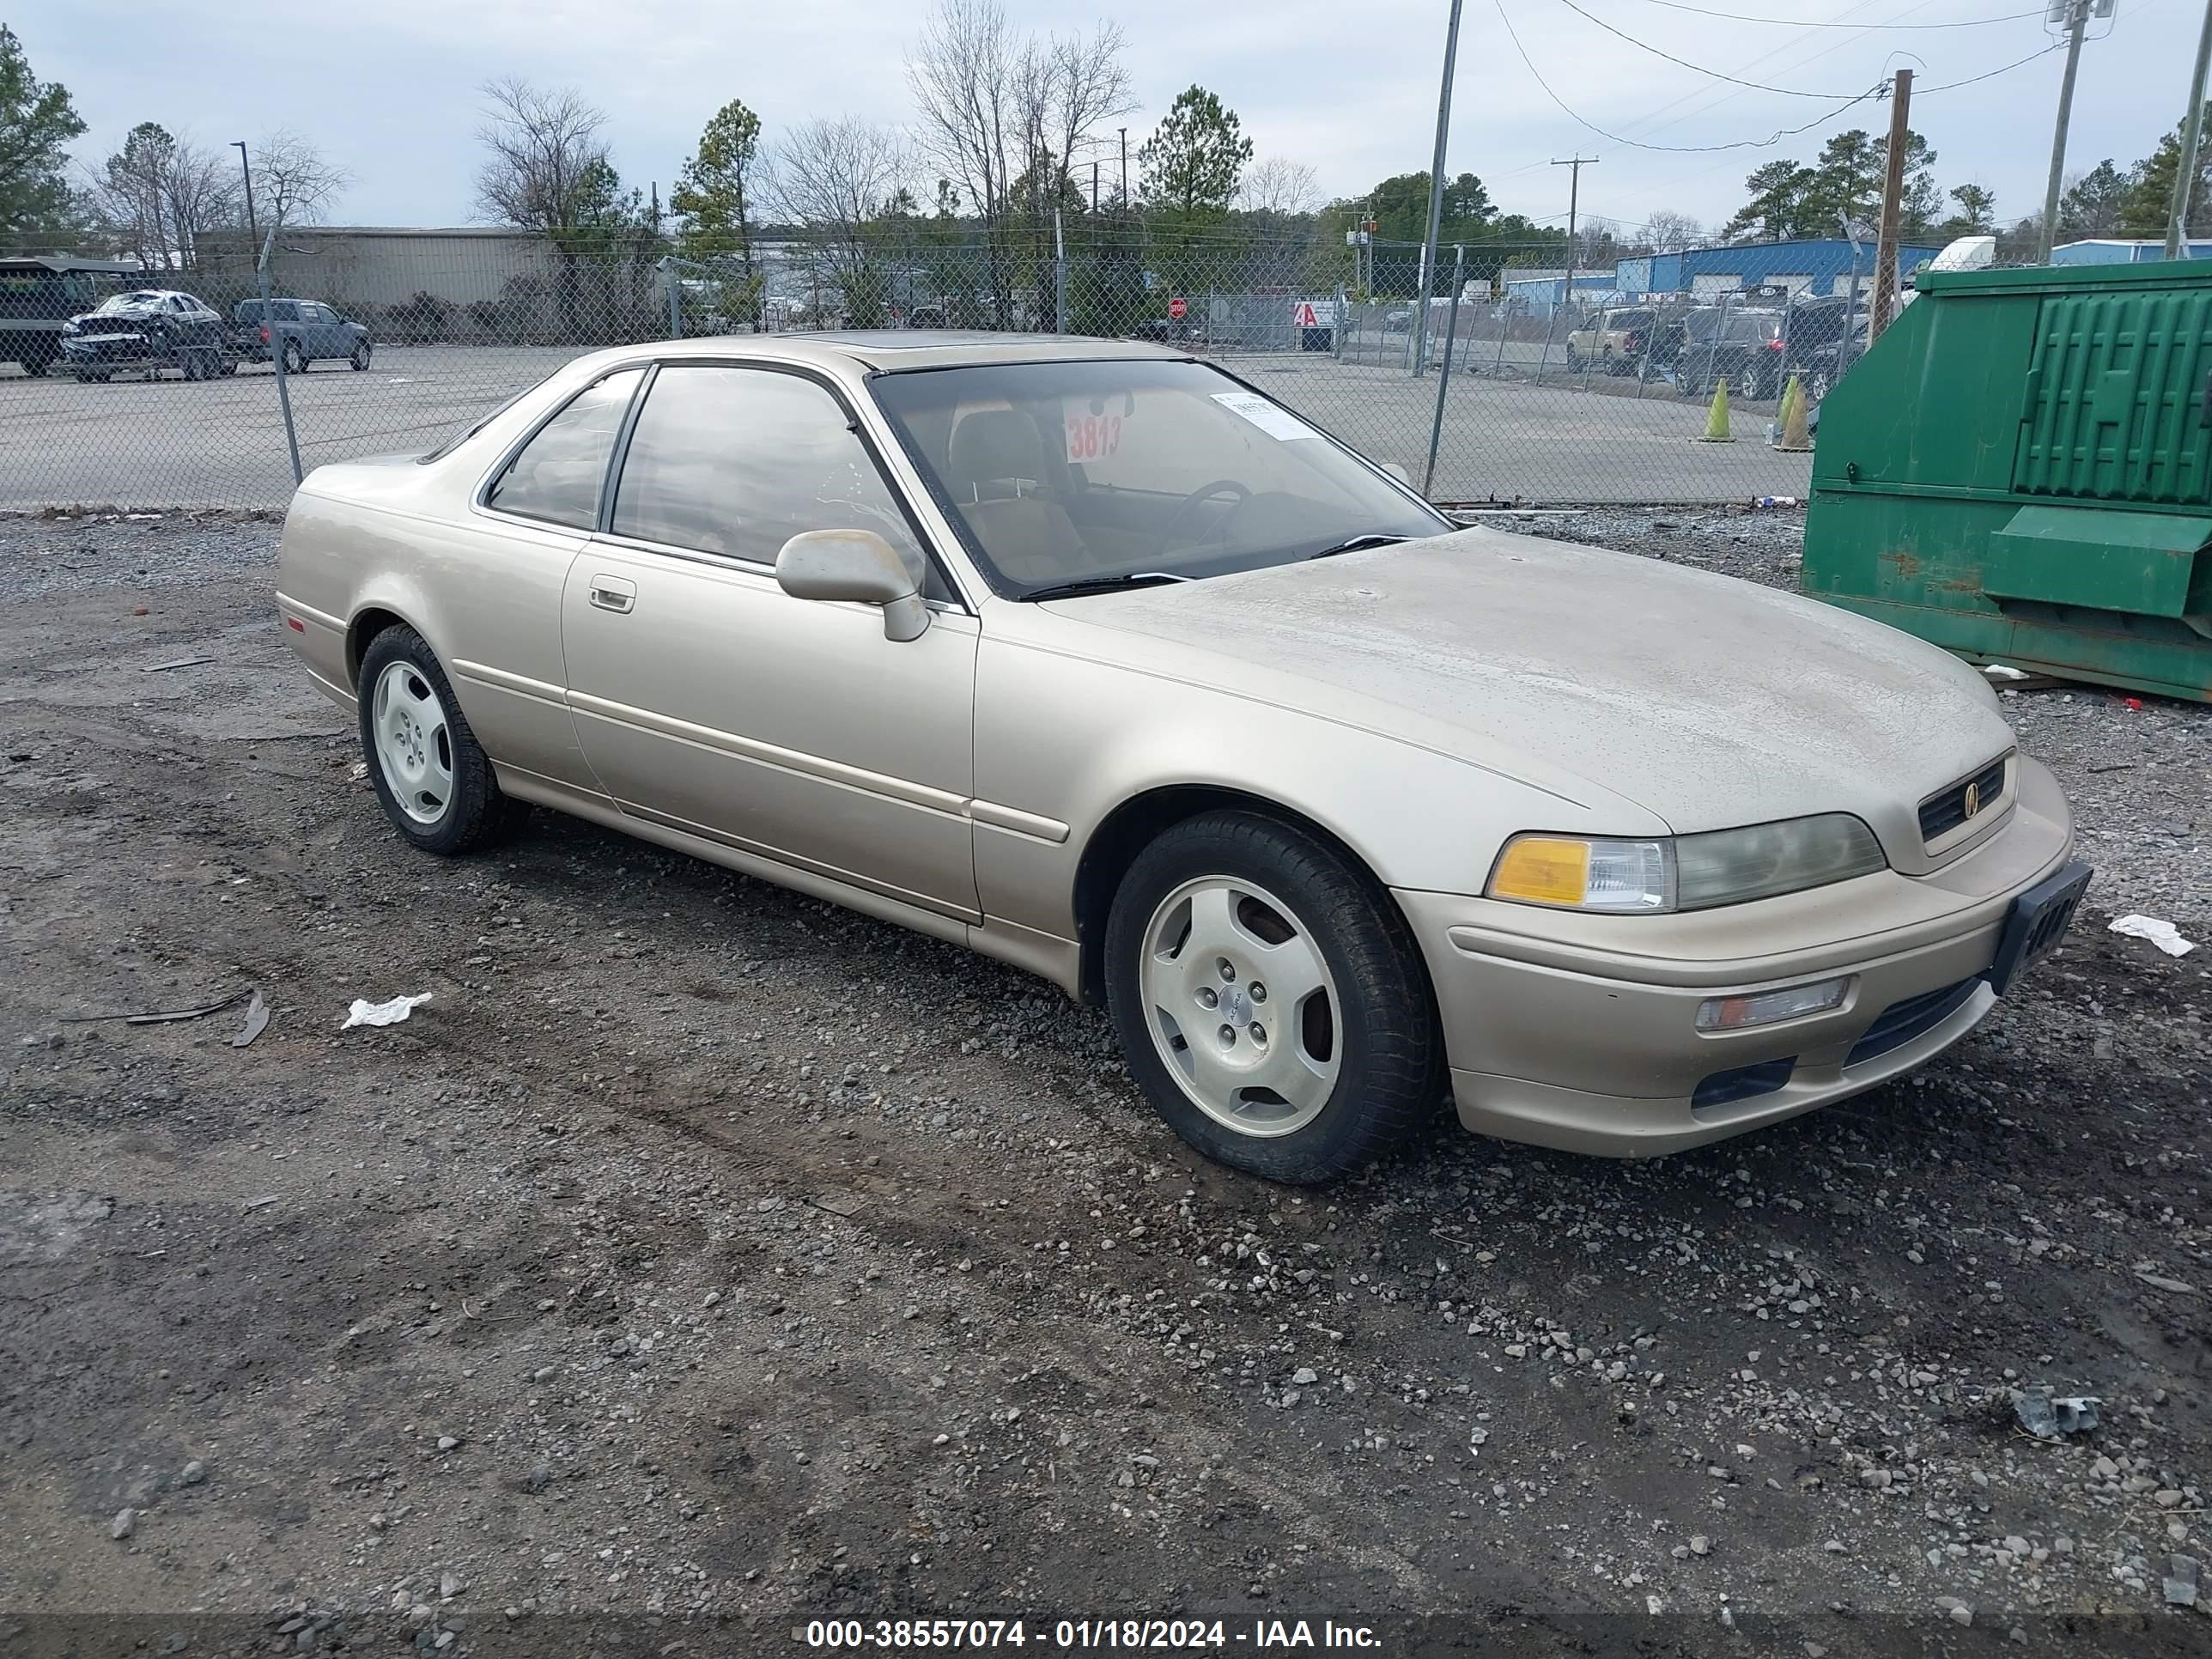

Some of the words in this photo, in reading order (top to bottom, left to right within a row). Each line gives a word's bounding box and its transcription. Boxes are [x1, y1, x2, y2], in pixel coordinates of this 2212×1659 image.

[1170, 304, 1186, 313] STOP
[1068, 415, 1121, 459] 3813
[1230, 993, 1243, 1022] ACURA
